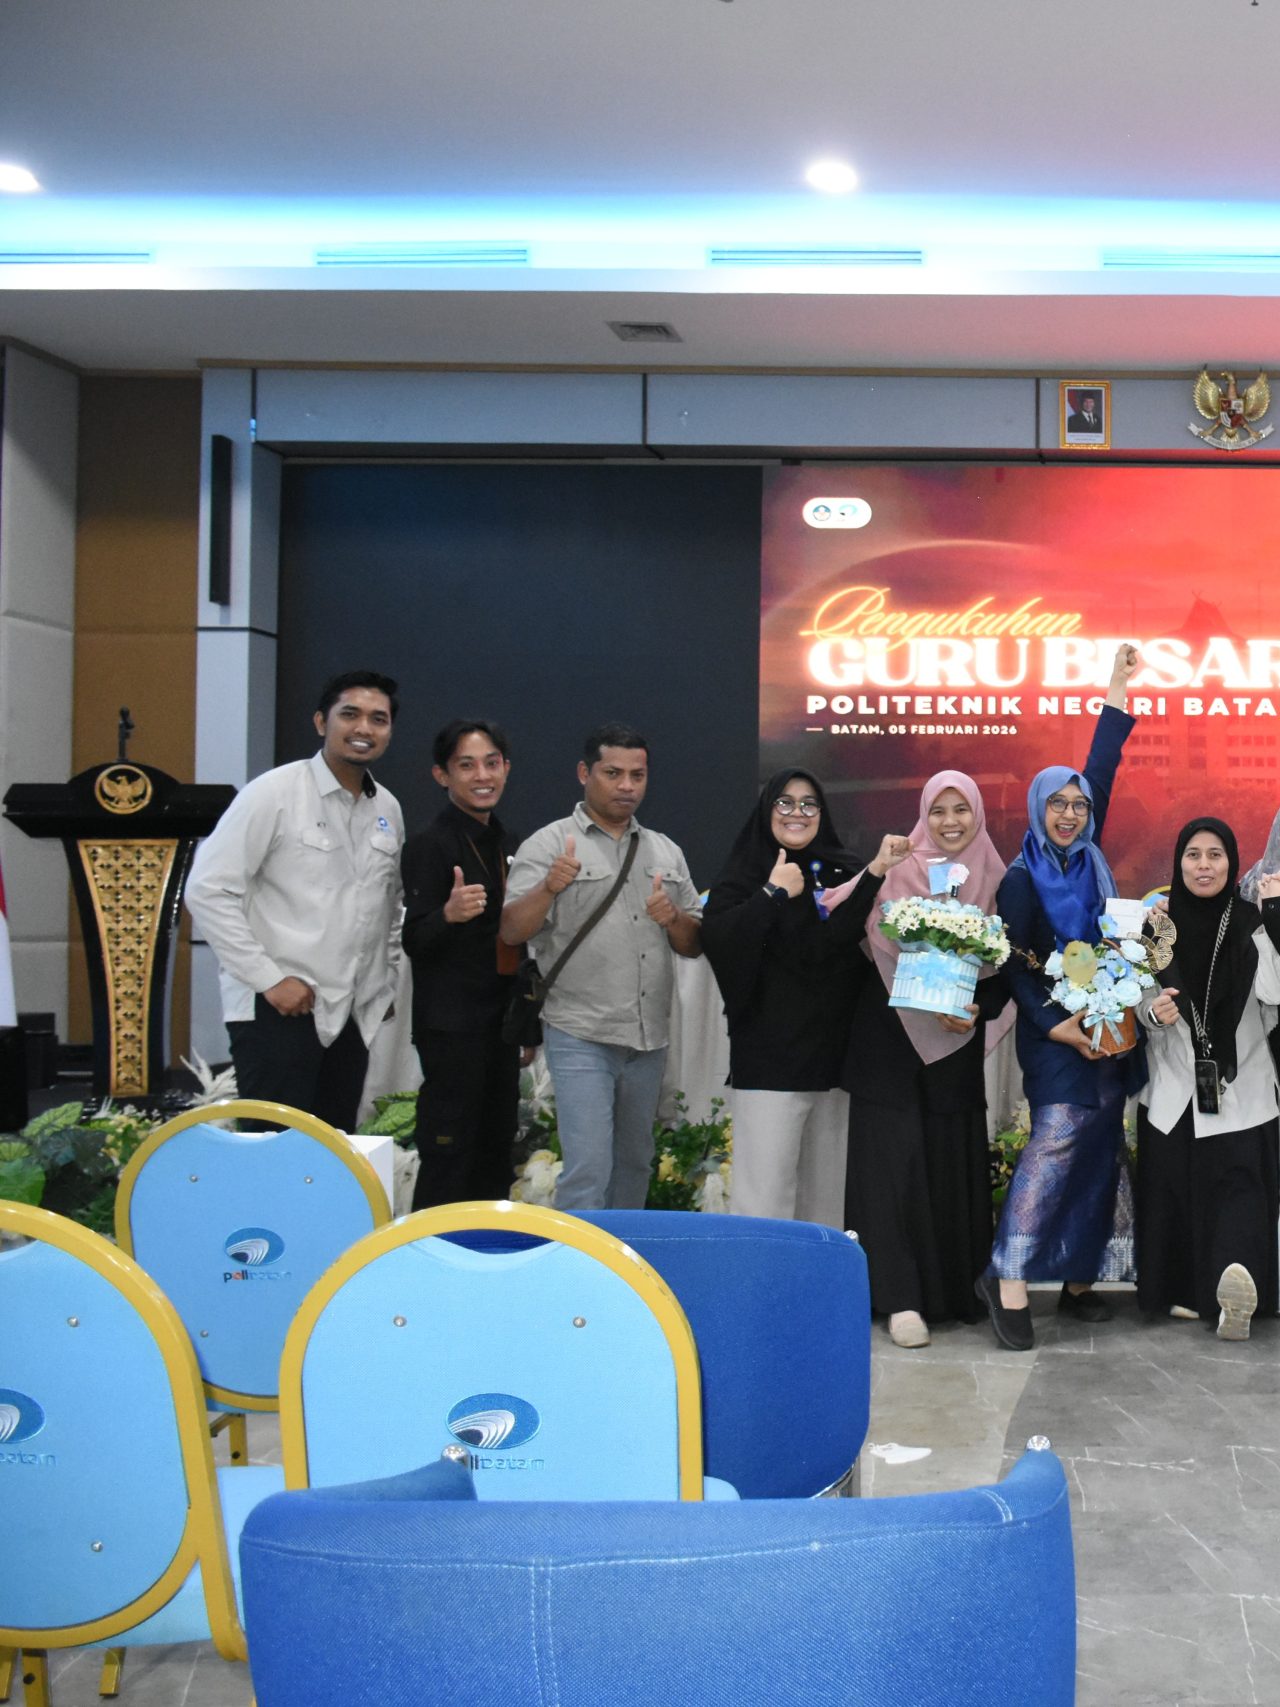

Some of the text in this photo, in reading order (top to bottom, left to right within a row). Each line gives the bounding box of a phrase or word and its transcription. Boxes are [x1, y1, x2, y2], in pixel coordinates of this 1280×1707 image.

[799, 586, 1083, 652] Pengukuhan
[808, 637, 1030, 687] GURU
[806, 695, 1022, 715] POLITEKNIK
[1038, 696, 1166, 715] NEGRI
[831, 725, 1018, 736] BATAM, 05 FEBRUARI 2026
